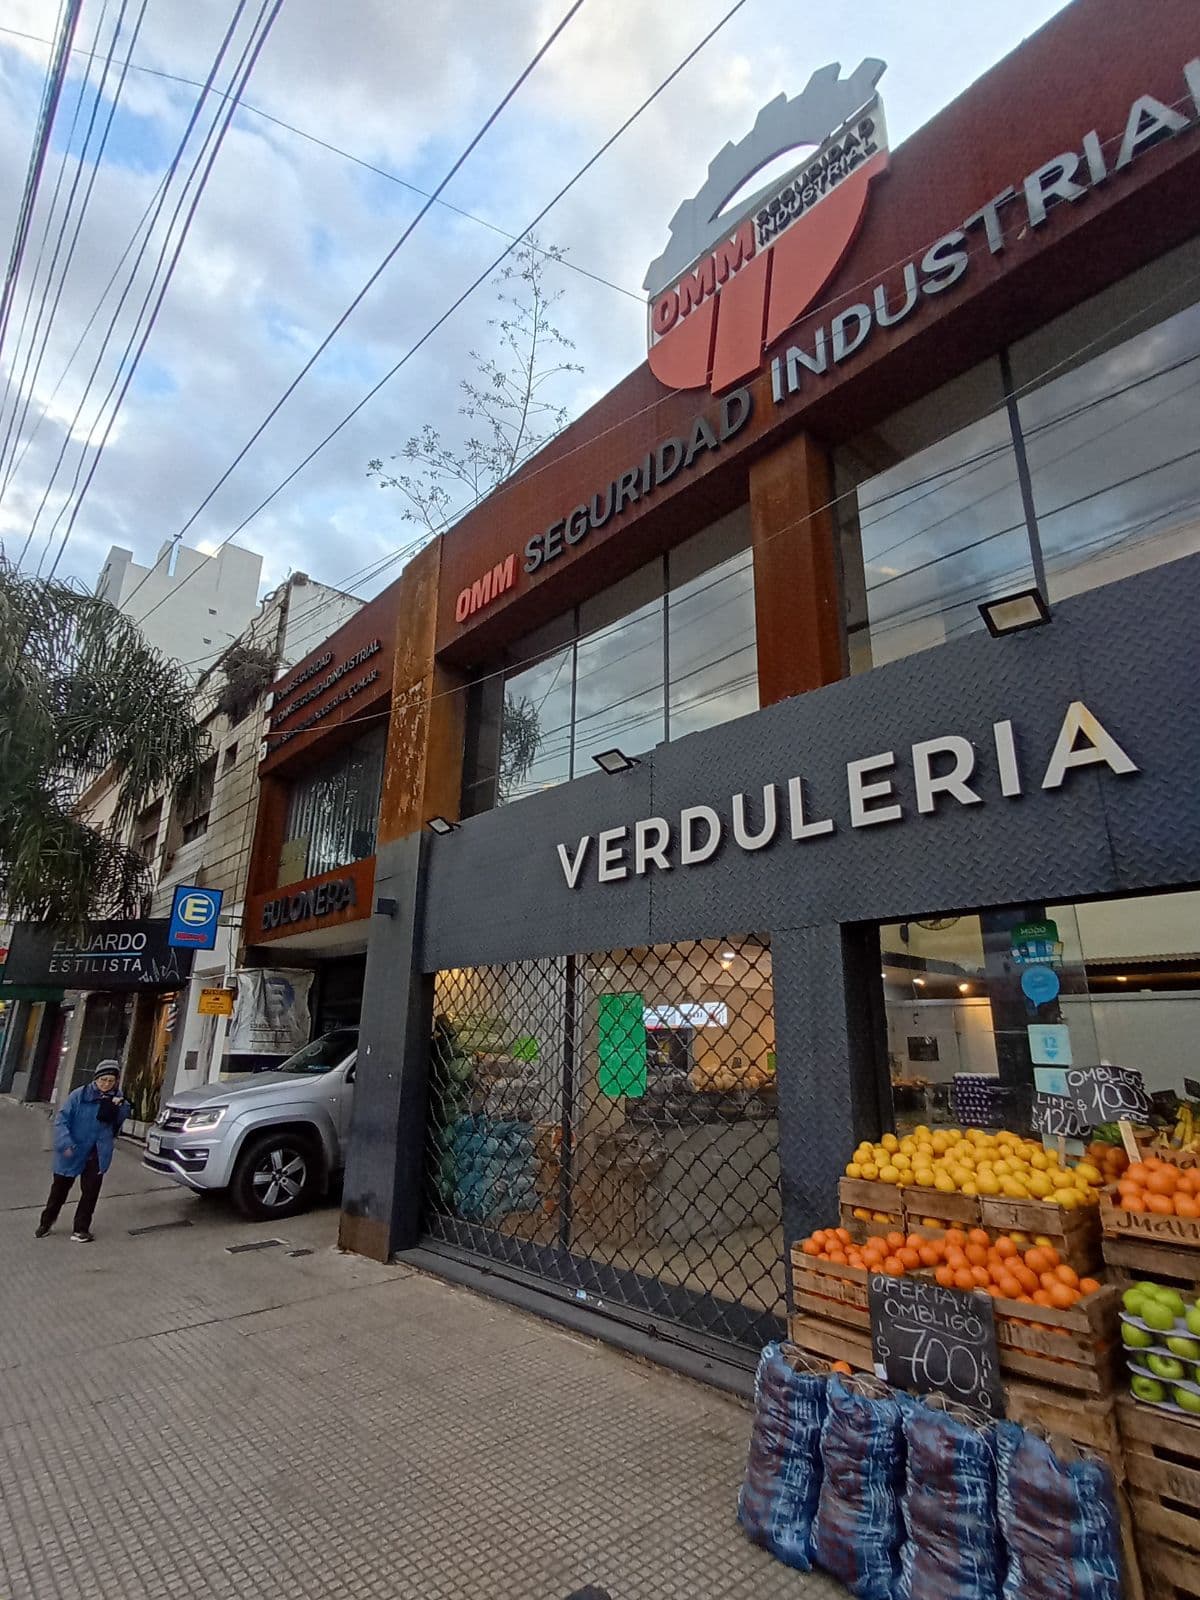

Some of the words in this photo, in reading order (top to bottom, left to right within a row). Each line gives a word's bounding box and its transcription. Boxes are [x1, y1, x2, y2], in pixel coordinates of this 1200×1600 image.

[758, 138, 878, 246] INDUSTRIAL
[653, 220, 756, 336] OMM
[455, 553, 522, 623] OMM
[523, 387, 753, 575] SEGURIDAD
[557, 701, 1139, 890] VERDULERIA
[184, 898, 209, 922] E
[49, 958, 142, 973] ESTILISTA
[884, 1298, 983, 1338] OMBLIGO
[893, 1323, 979, 1394] 700
